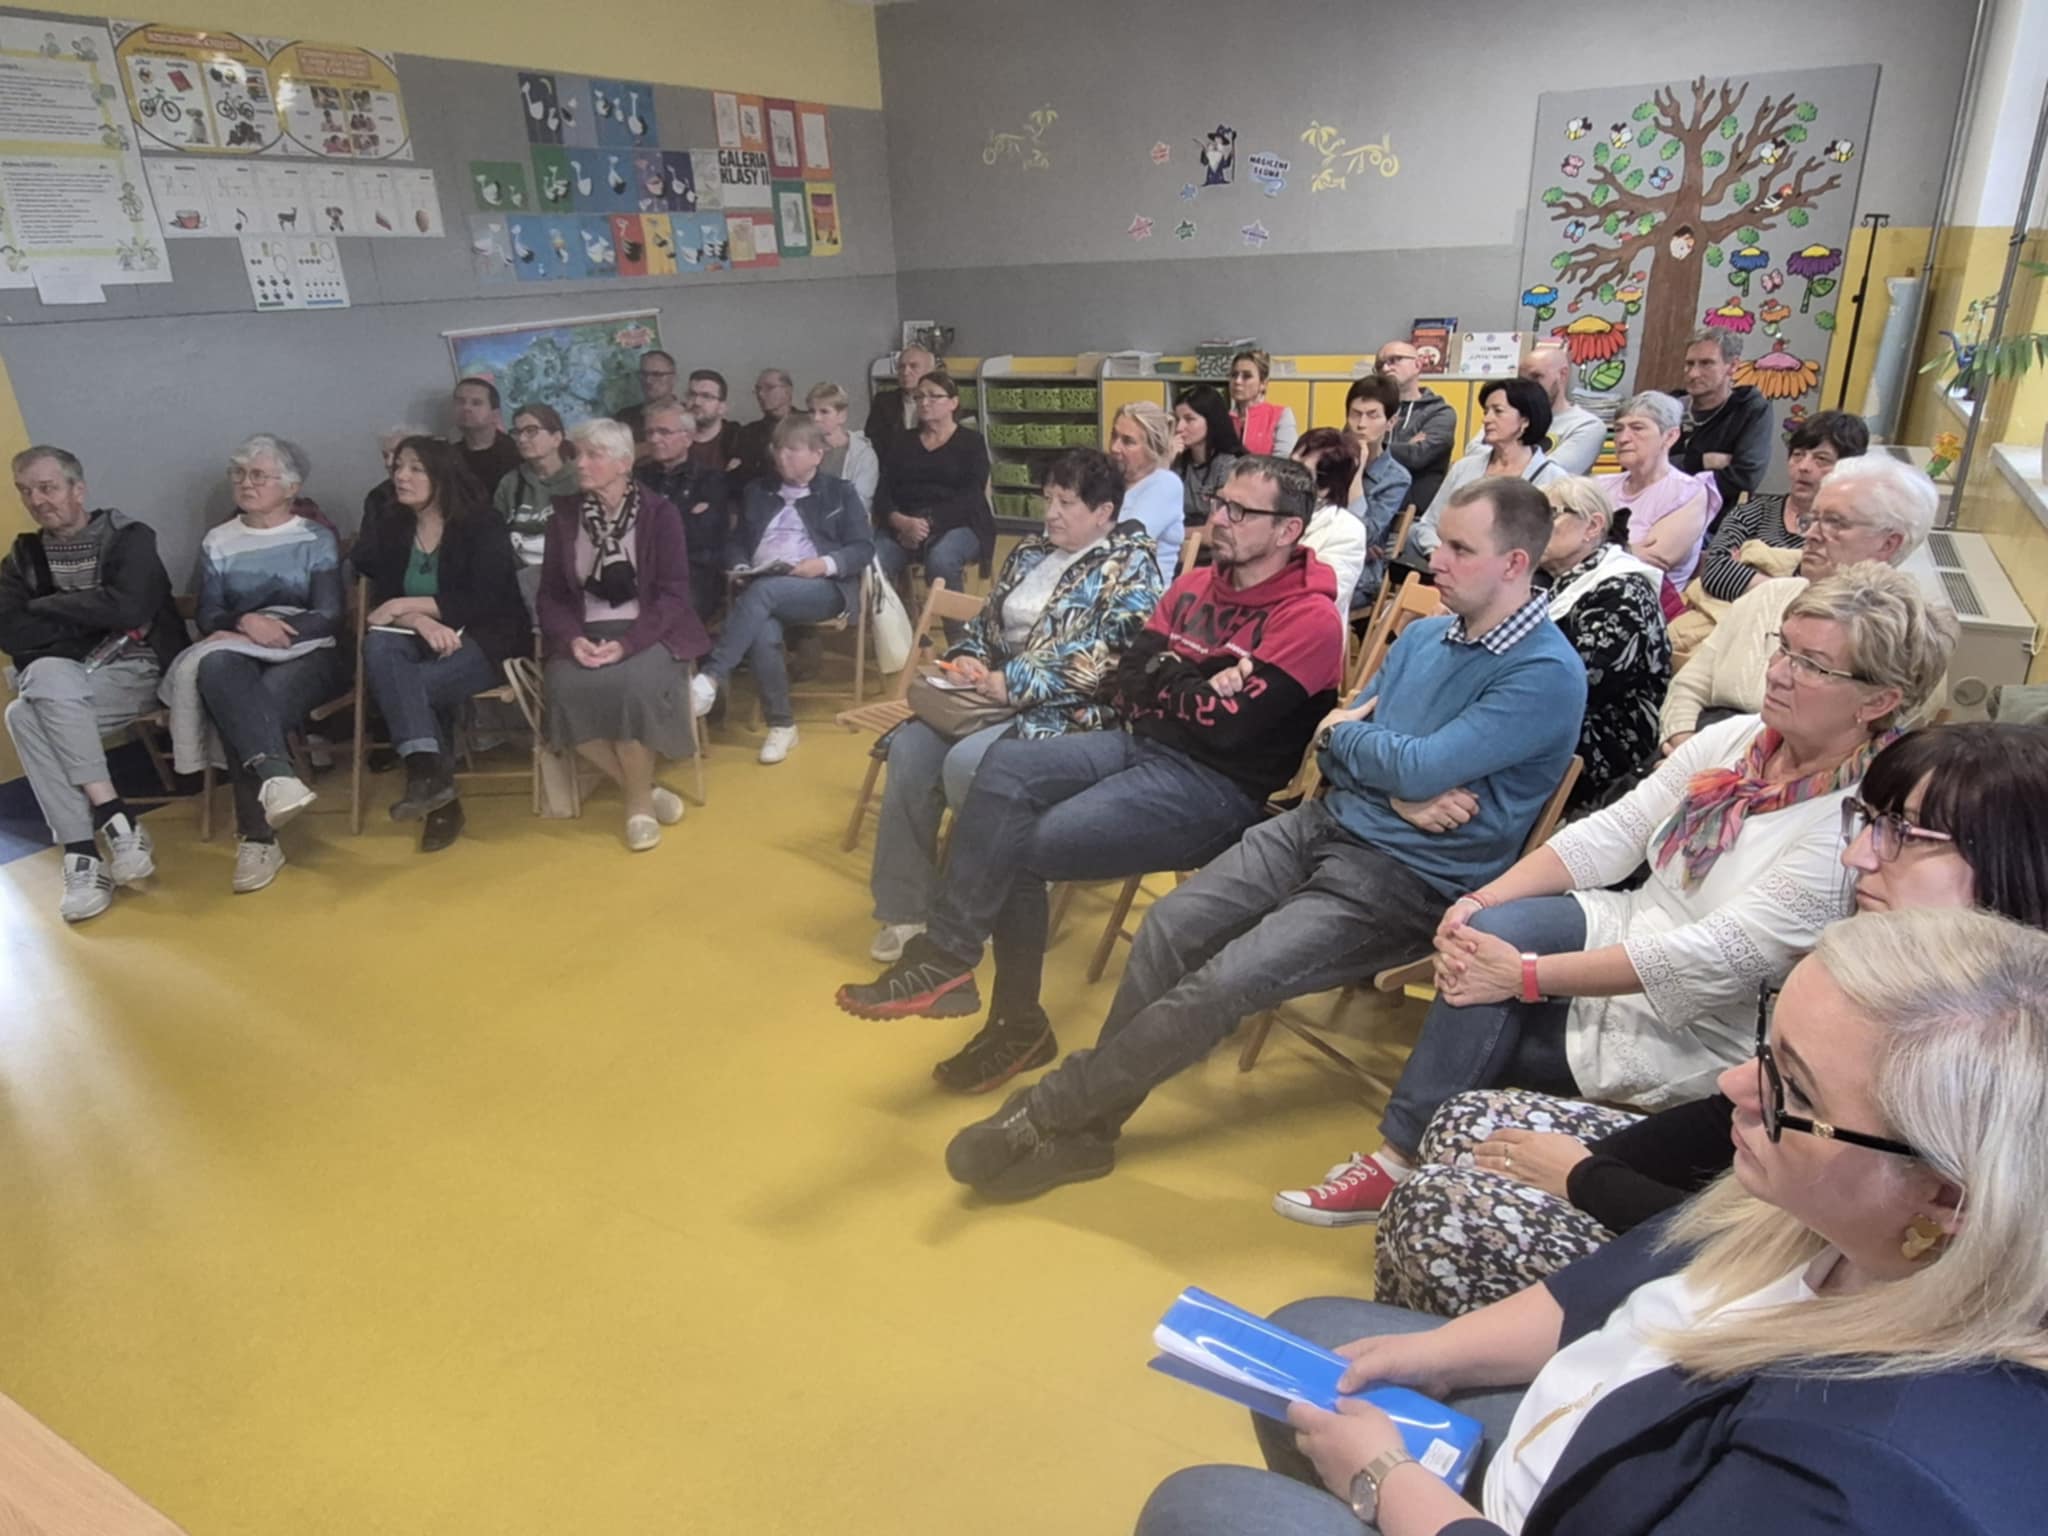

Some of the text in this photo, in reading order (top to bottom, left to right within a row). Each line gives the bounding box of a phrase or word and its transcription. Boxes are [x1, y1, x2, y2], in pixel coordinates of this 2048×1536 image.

[718, 150, 767, 168] GALERIA
[720, 168, 770, 185] KLASY II
